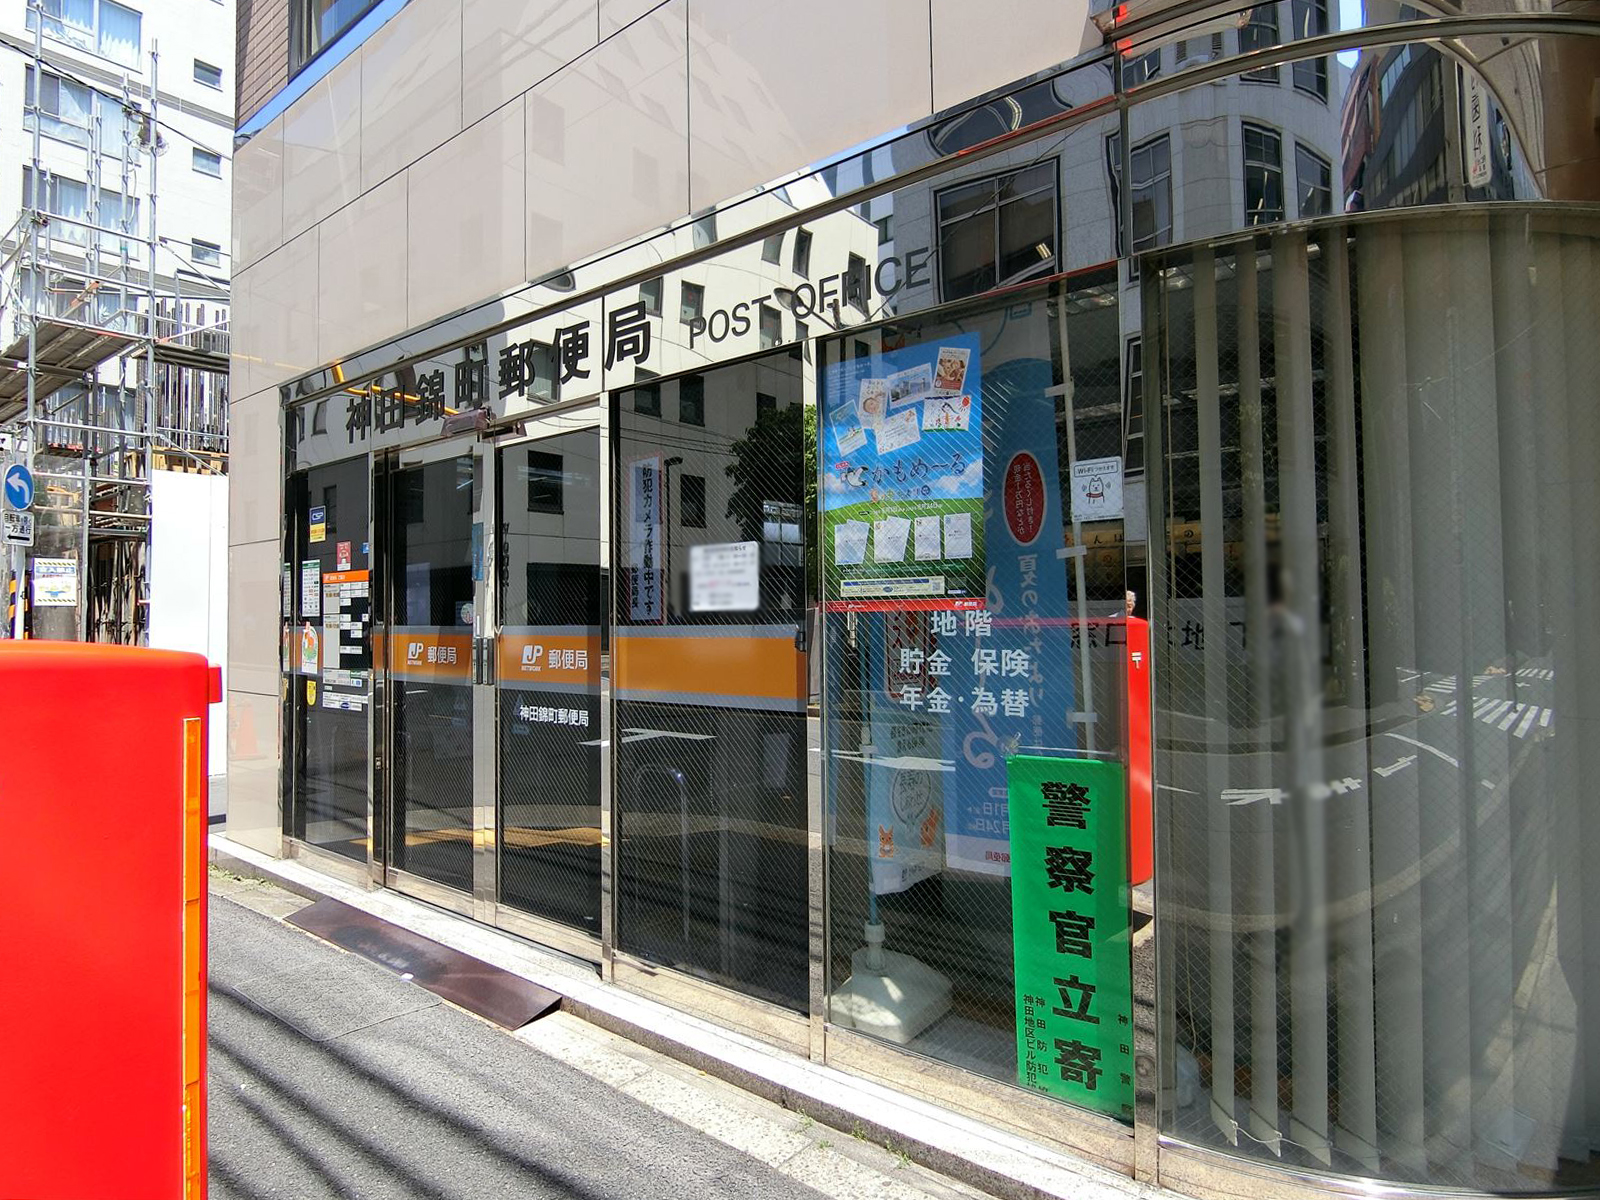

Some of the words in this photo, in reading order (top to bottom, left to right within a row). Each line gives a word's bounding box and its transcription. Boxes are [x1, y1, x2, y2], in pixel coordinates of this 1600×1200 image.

[346, 300, 652, 445] 神田錦町郵便局
[690, 294, 772, 349] POST
[791, 247, 931, 319] OFFICE
[427, 646, 457, 665] 郵便局
[548, 649, 588, 670] 郵便局
[899, 648, 952, 676] 貯金
[971, 648, 1031, 678] 保険
[519, 704, 589, 727] 神田錦町郵便局
[1040, 781, 1103, 1092] 警察官立寄
